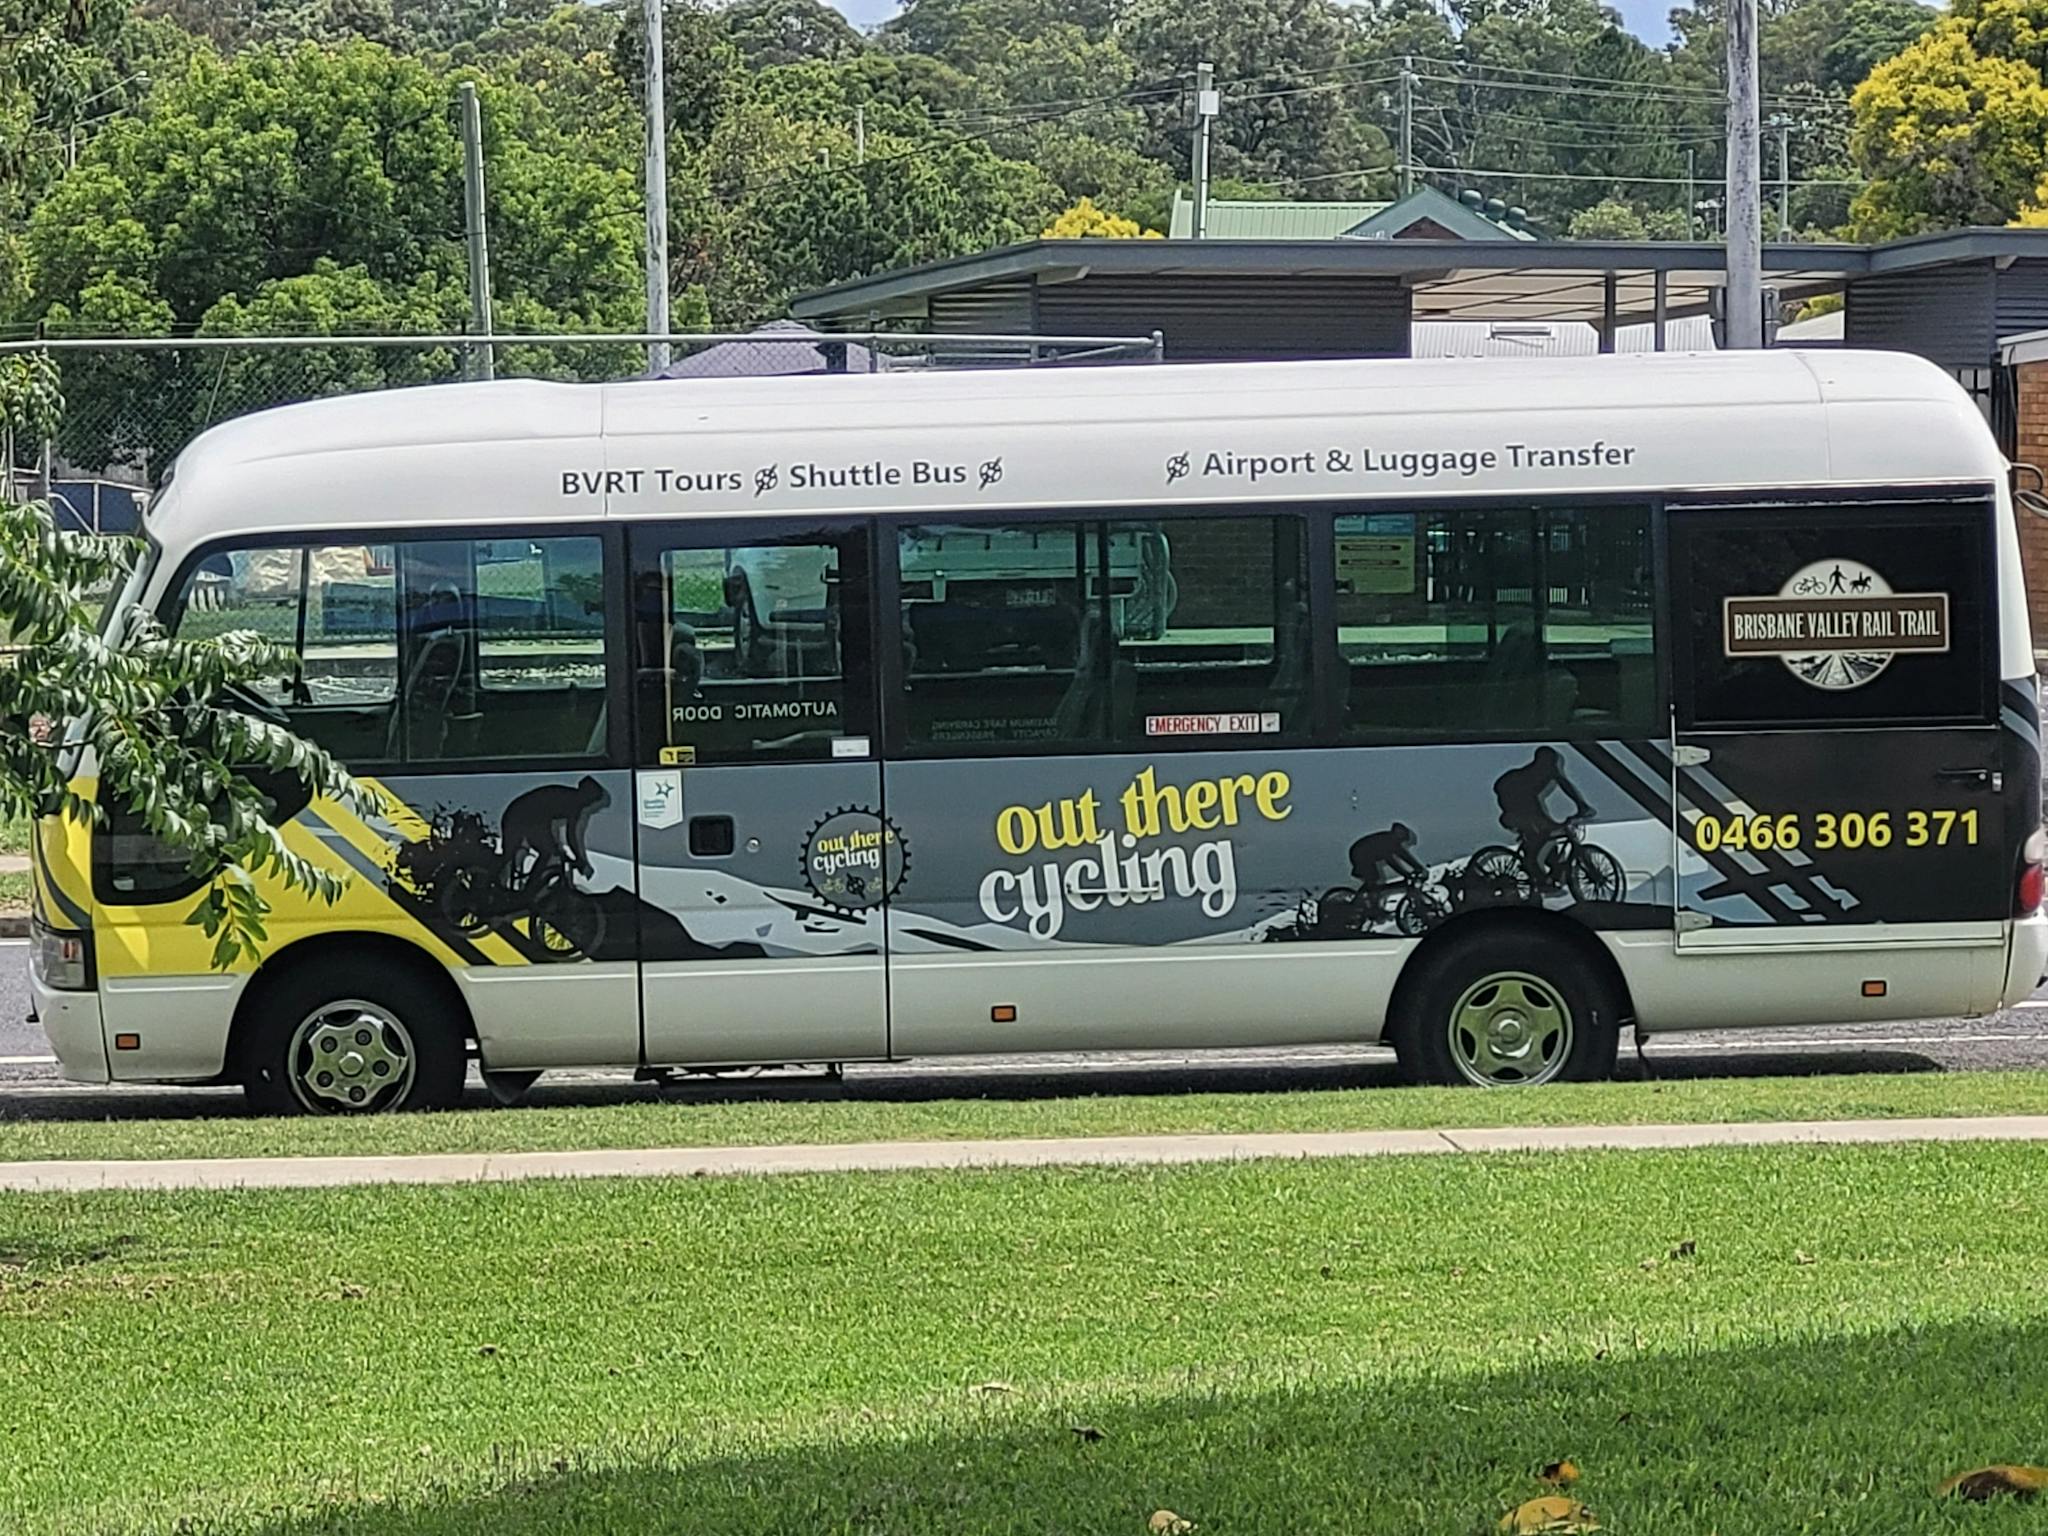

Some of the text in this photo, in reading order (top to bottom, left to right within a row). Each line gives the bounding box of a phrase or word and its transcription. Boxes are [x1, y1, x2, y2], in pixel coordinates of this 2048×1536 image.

[561, 461, 966, 495] BVRT Tours Shuttle Bus
[1203, 442, 1636, 481] Airport & Luggage Transfer
[1733, 609, 1940, 640] BRISBANE VALLEY RAIL TRAIL
[1147, 714, 1257, 733] EMERGENCY EXIT
[996, 765, 1292, 854] out there
[817, 830, 895, 853] out there
[1695, 809, 1979, 851] 0466 306 371
[813, 847, 880, 875] cycling
[979, 828, 1237, 940] cycling
